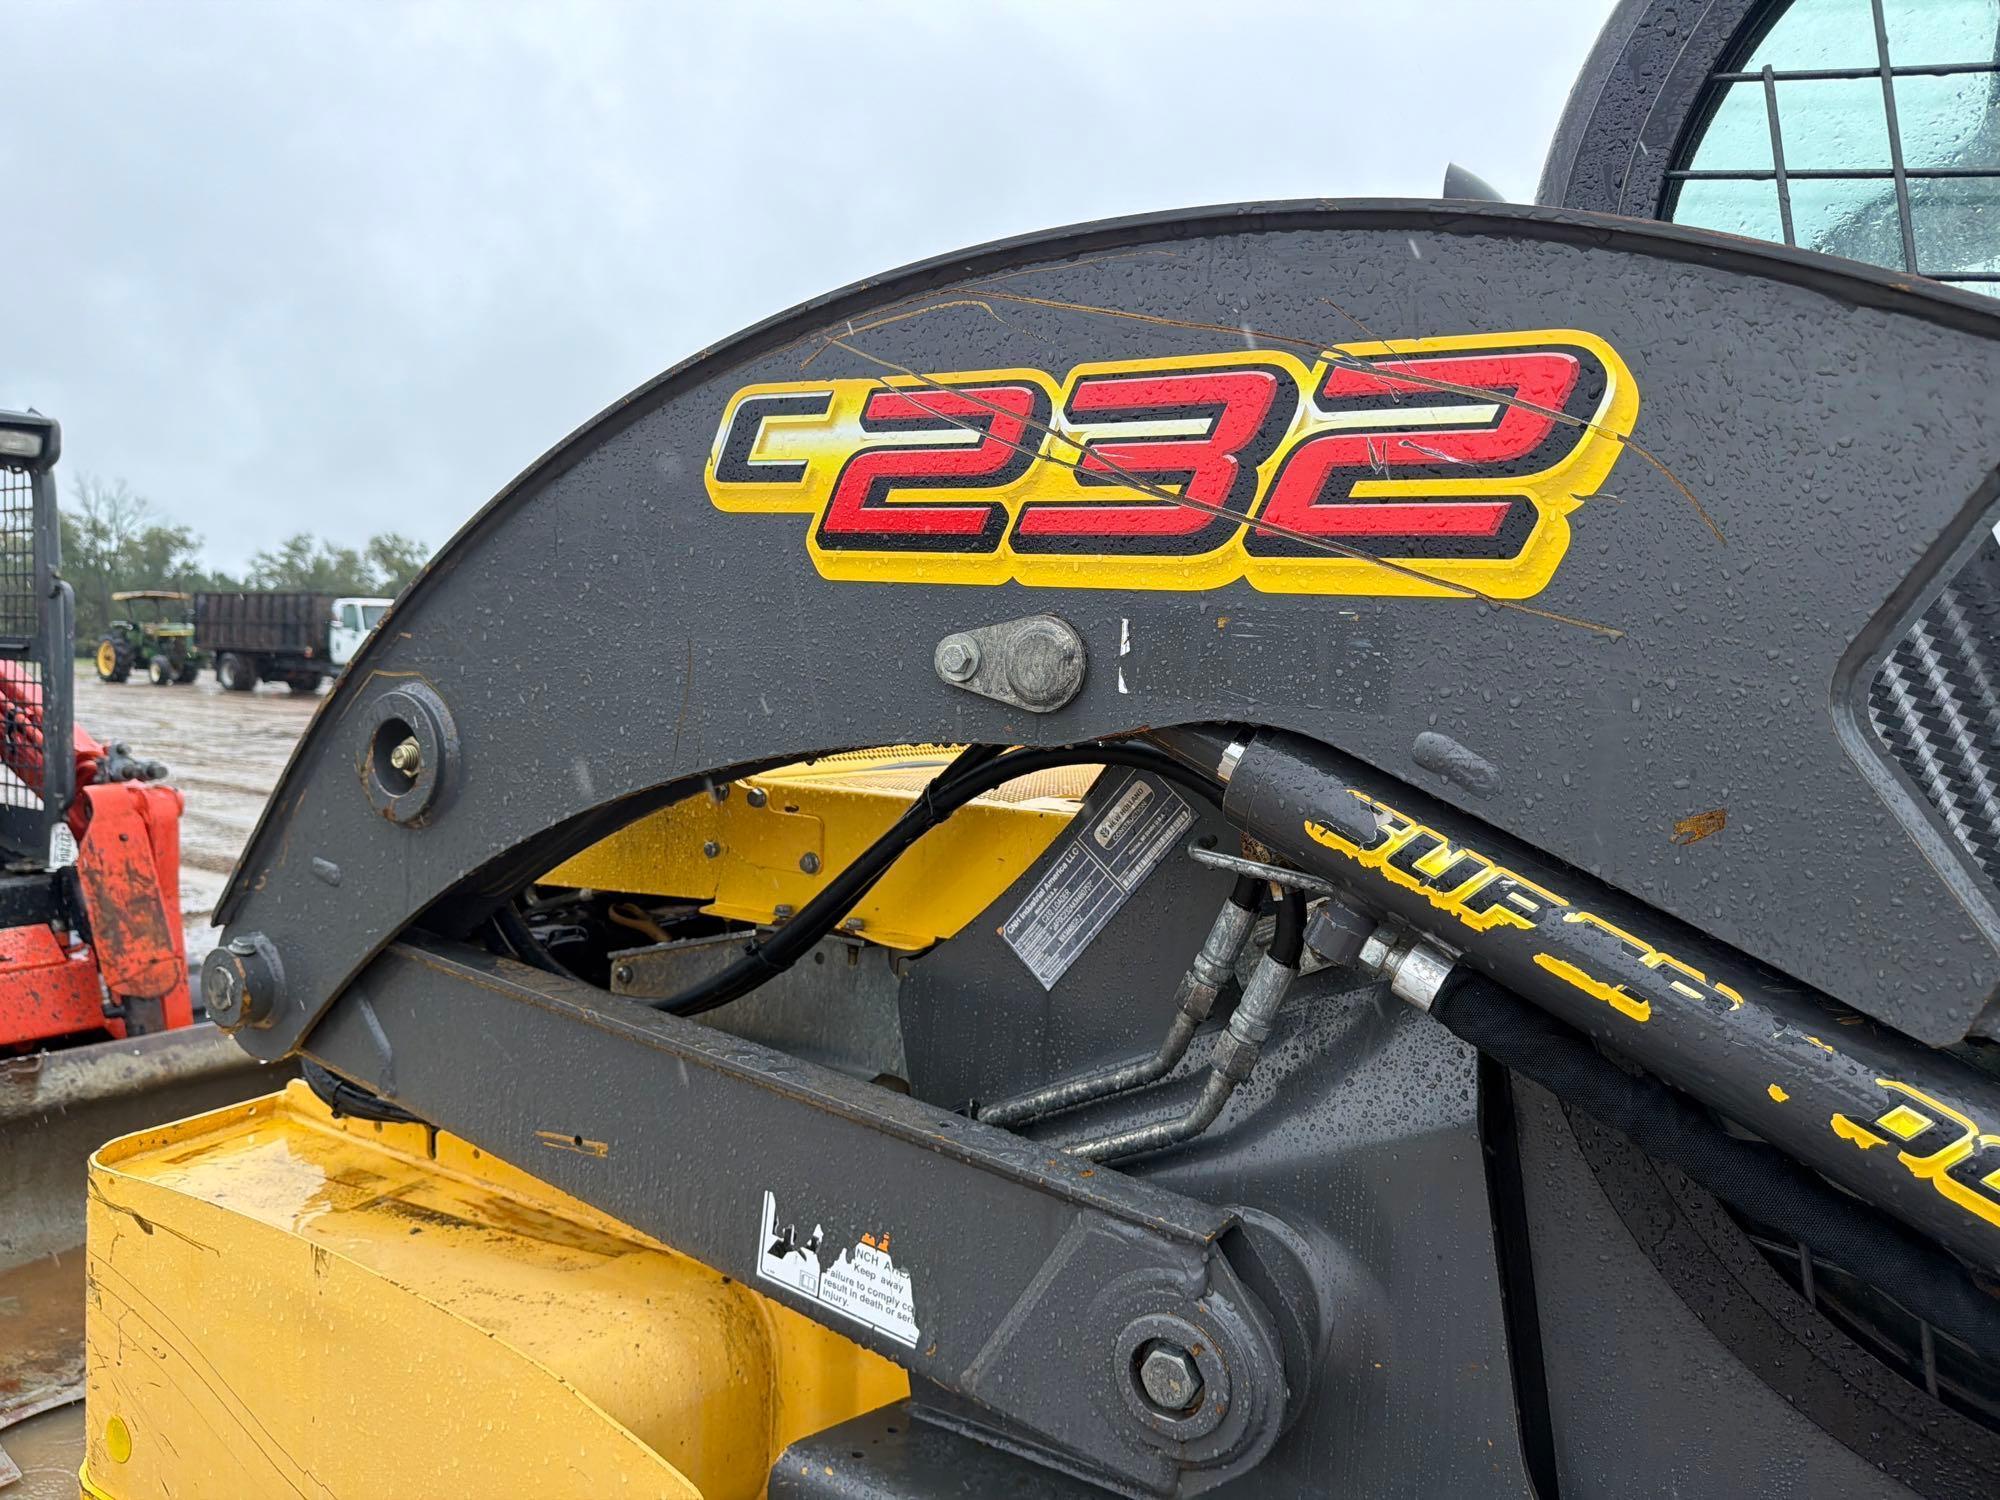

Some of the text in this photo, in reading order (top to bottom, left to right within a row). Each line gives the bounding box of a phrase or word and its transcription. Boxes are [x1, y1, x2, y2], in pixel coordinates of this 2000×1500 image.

[714, 344, 1614, 559] C232
[1107, 786, 1144, 830] NEW HOLLAND
[1112, 800, 1147, 841] CONSTRUCTION
[1006, 916, 1021, 935] CNH
[1018, 886, 1046, 920] Industrial
[1042, 860, 1068, 890] America
[1064, 846, 1079, 864] LLC
[1051, 887, 1071, 911] LOADER
[824, 1278, 848, 1295] result
[849, 1286, 858, 1298] in
[859, 1290, 883, 1312] death
[885, 1306, 895, 1316] or
[828, 1268, 855, 1286] ailure
[857, 1280, 866, 1291] to
[867, 1285, 899, 1305] comply
[853, 1263, 904, 1293] Keep away
[823, 1288, 849, 1307] injury.
